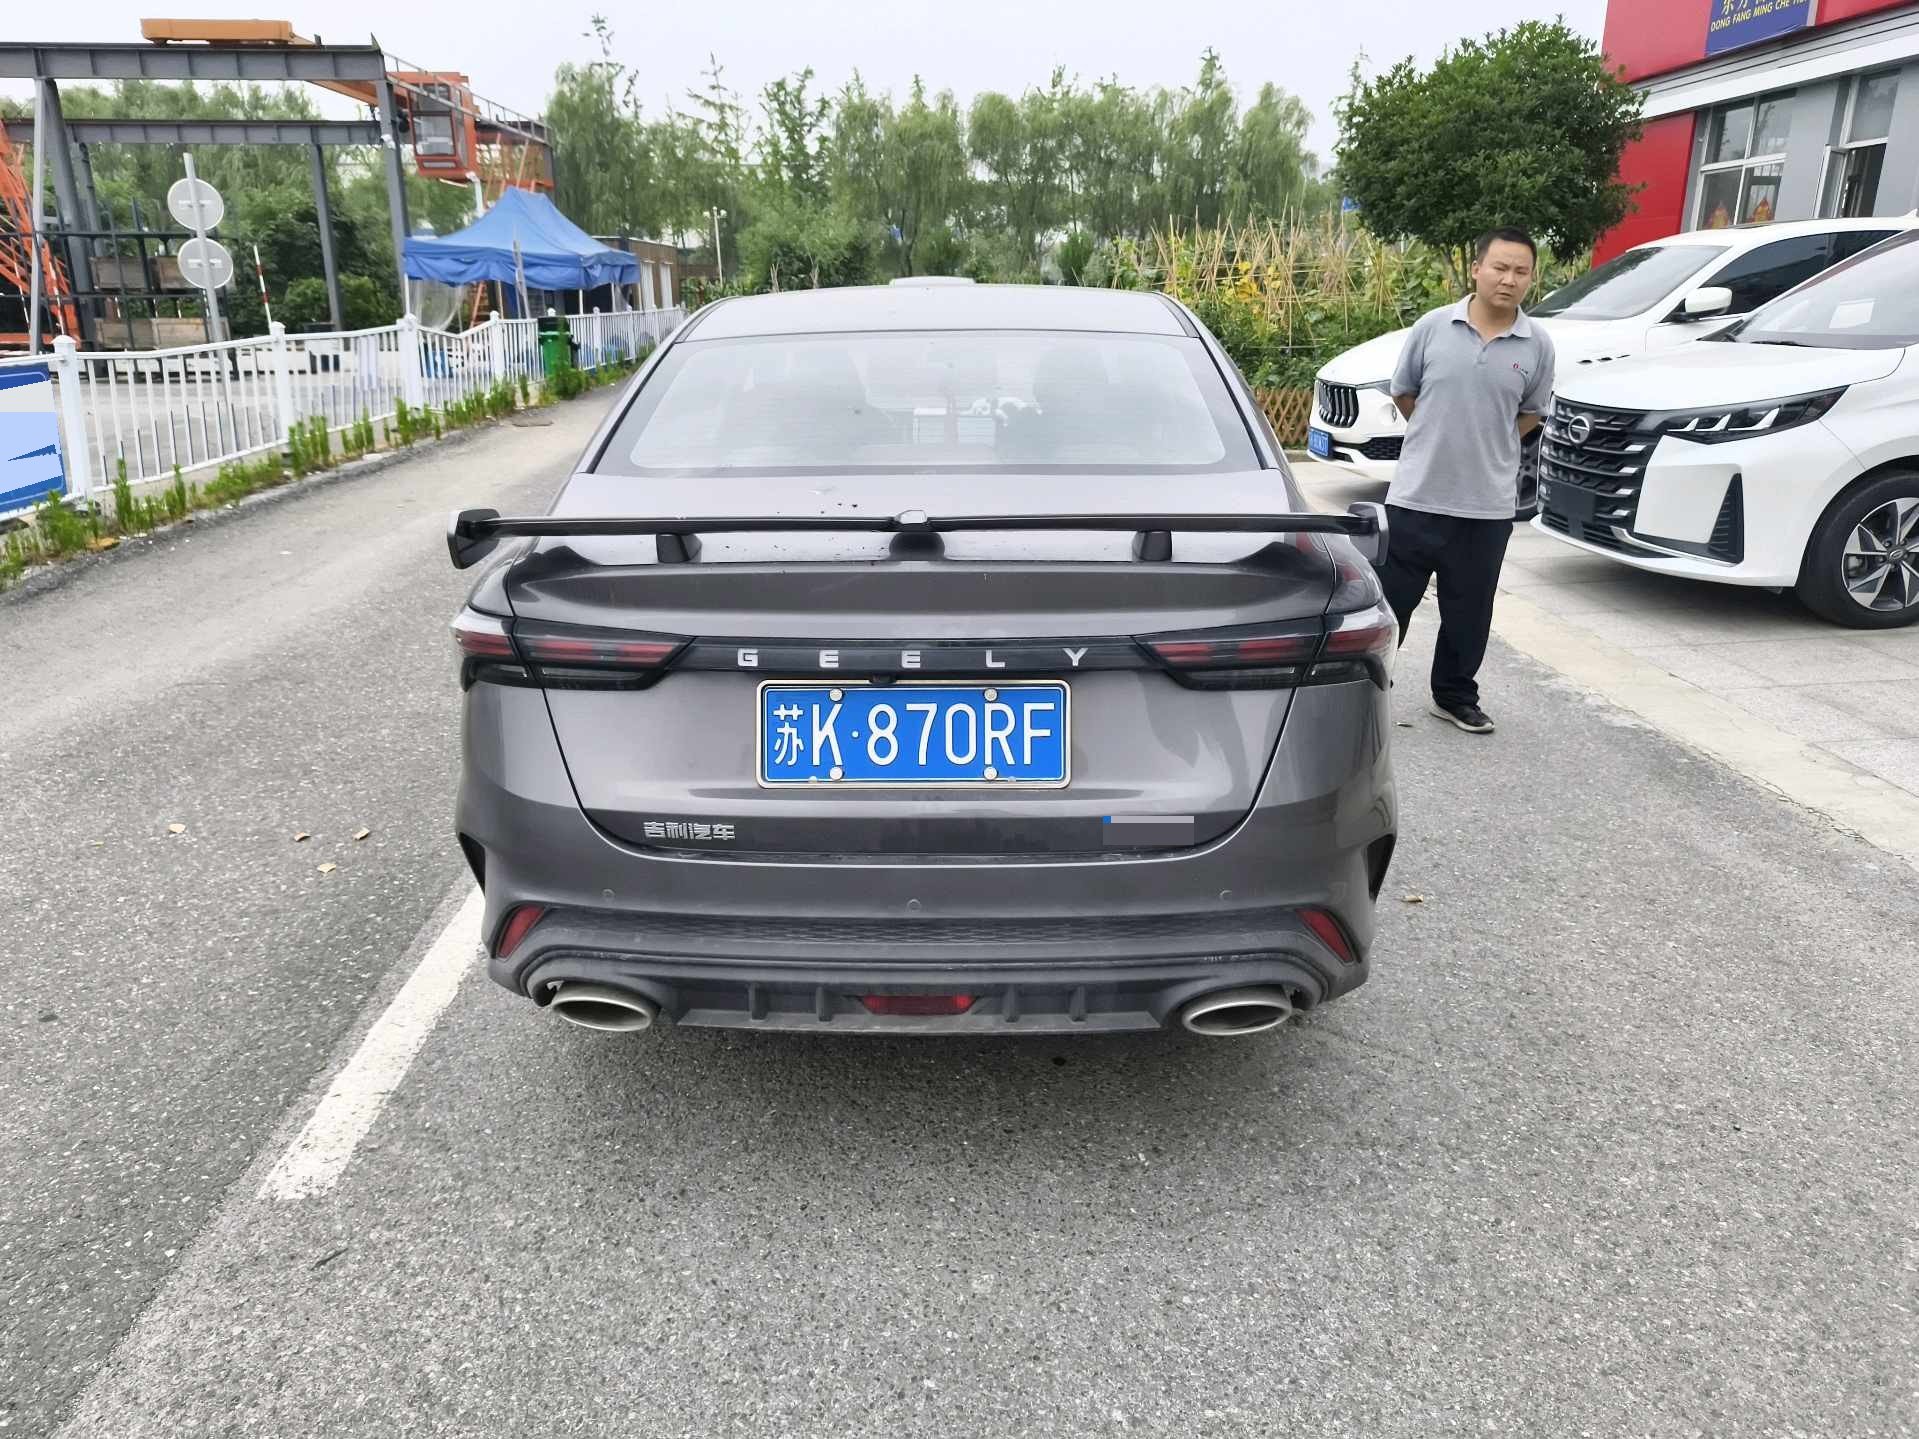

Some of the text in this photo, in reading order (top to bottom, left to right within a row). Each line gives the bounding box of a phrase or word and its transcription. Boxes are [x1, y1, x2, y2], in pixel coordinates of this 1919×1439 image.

[1711, 16, 1731, 32] DONG
[1732, 9, 1752, 24] FANG
[1753, 2, 1773, 17] MING
[737, 647, 1089, 669] GEELY
[643, 821, 736, 841] 吉利汽车
